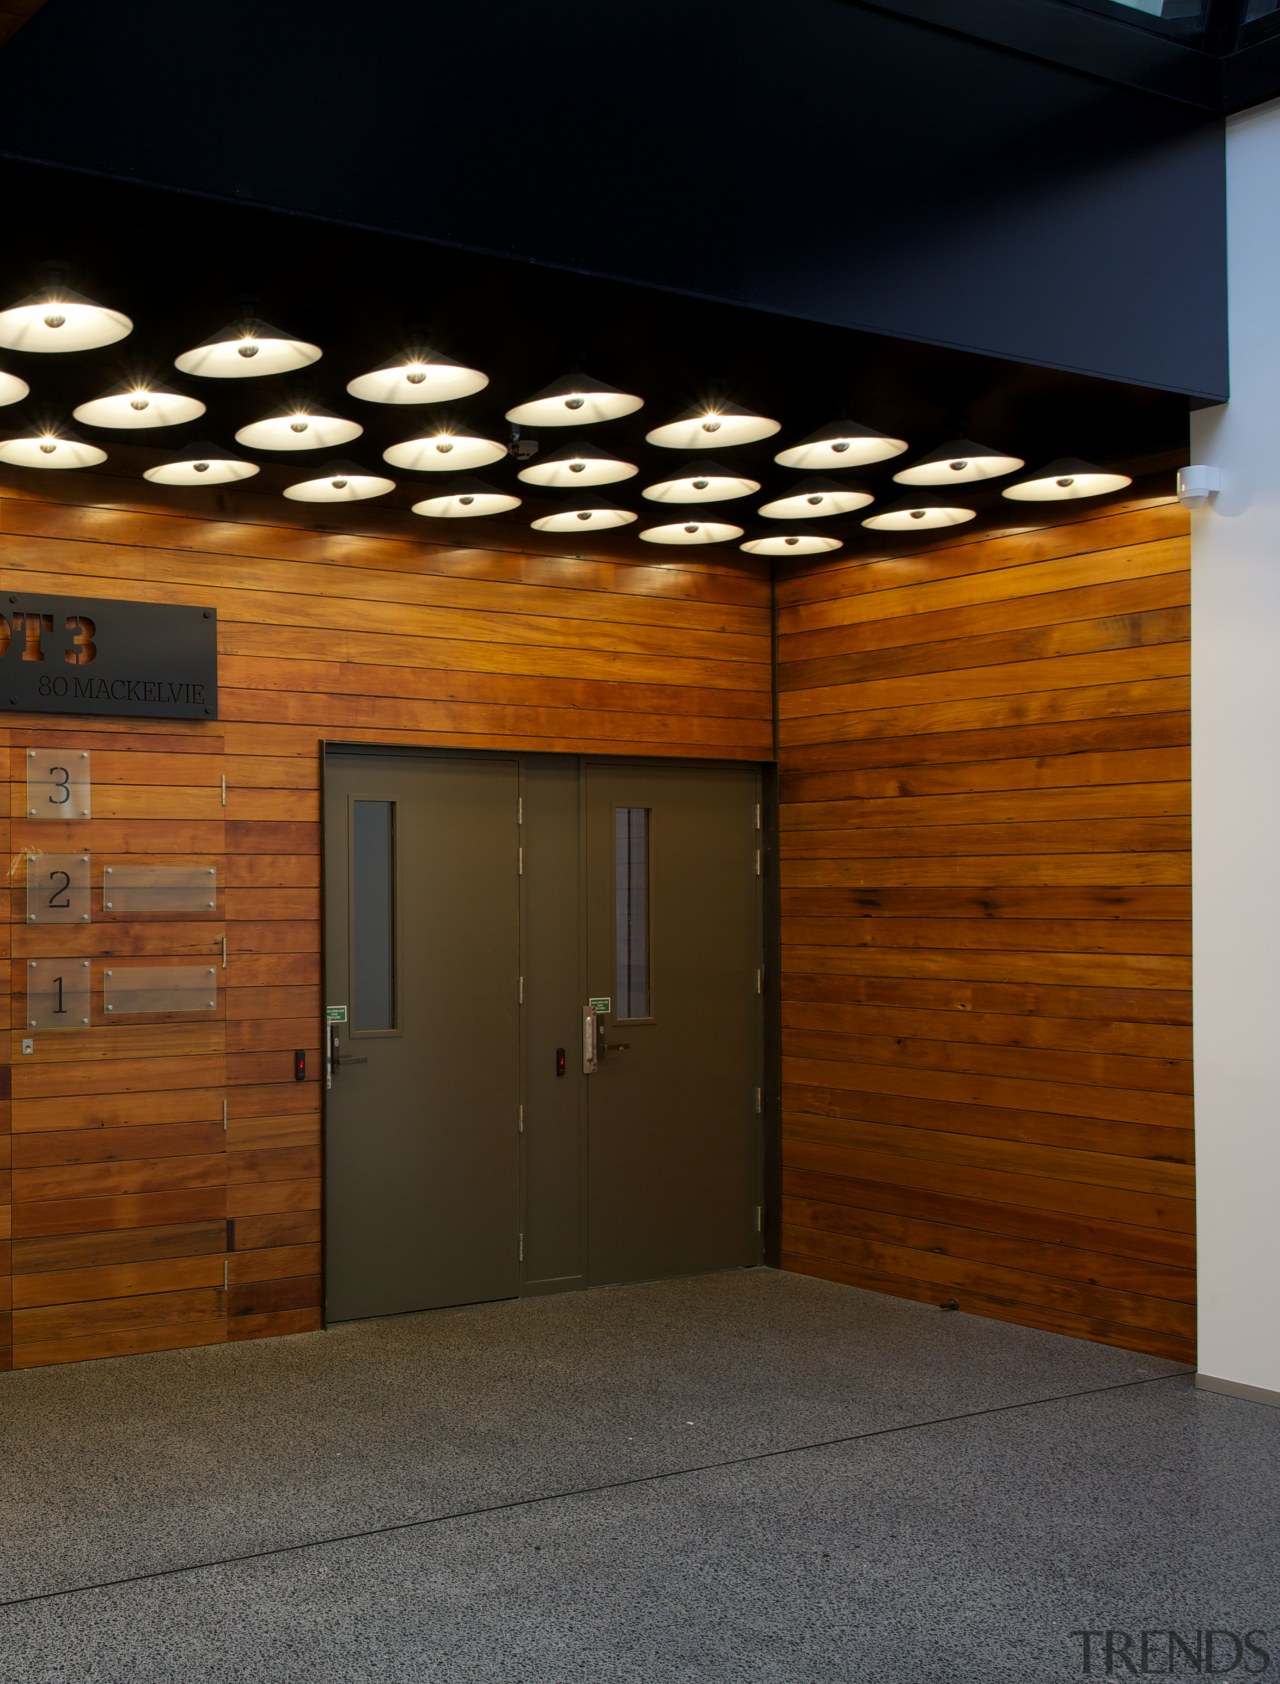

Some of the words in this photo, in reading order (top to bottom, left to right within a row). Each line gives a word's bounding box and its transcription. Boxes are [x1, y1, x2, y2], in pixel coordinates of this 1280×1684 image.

[64, 615, 98, 665] 3
[38, 675, 68, 698] 80
[73, 677, 205, 705] MACKELVIE
[48, 766, 71, 805] 3
[48, 870, 71, 908] 2
[51, 976, 68, 1014] 1
